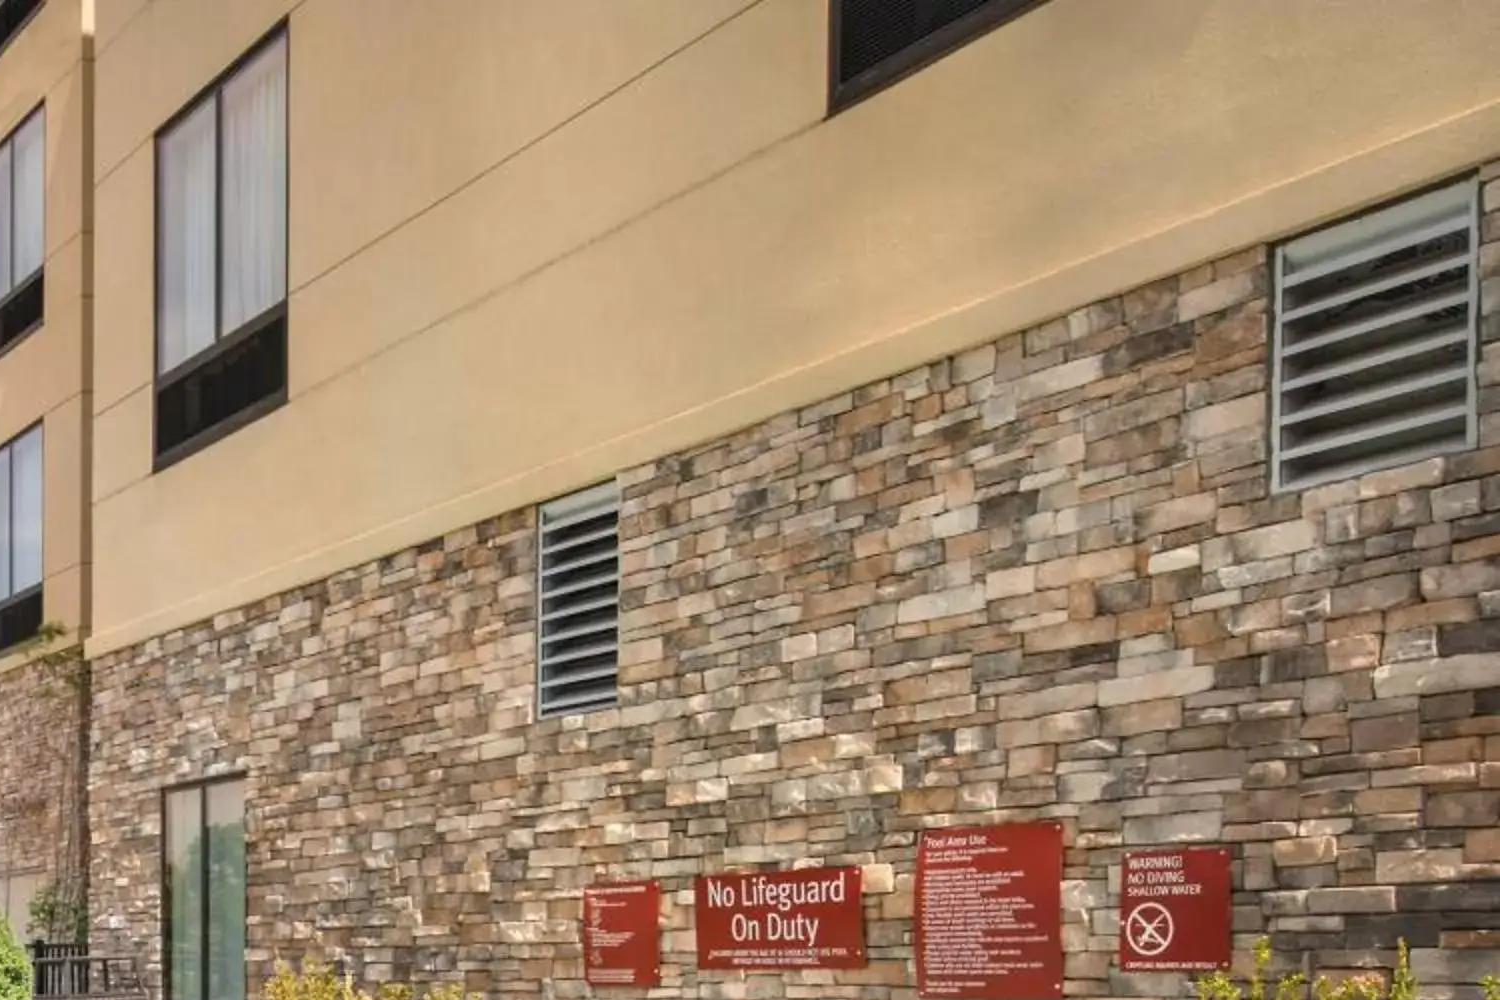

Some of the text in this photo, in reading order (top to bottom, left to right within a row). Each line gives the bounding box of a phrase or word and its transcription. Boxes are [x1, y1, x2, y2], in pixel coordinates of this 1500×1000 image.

[1127, 870, 1185, 885] NO DIVING
[707, 871, 845, 911] No Lifeguard
[1127, 883, 1202, 897] SHALLOW WATER
[731, 913, 819, 947] On Duty
